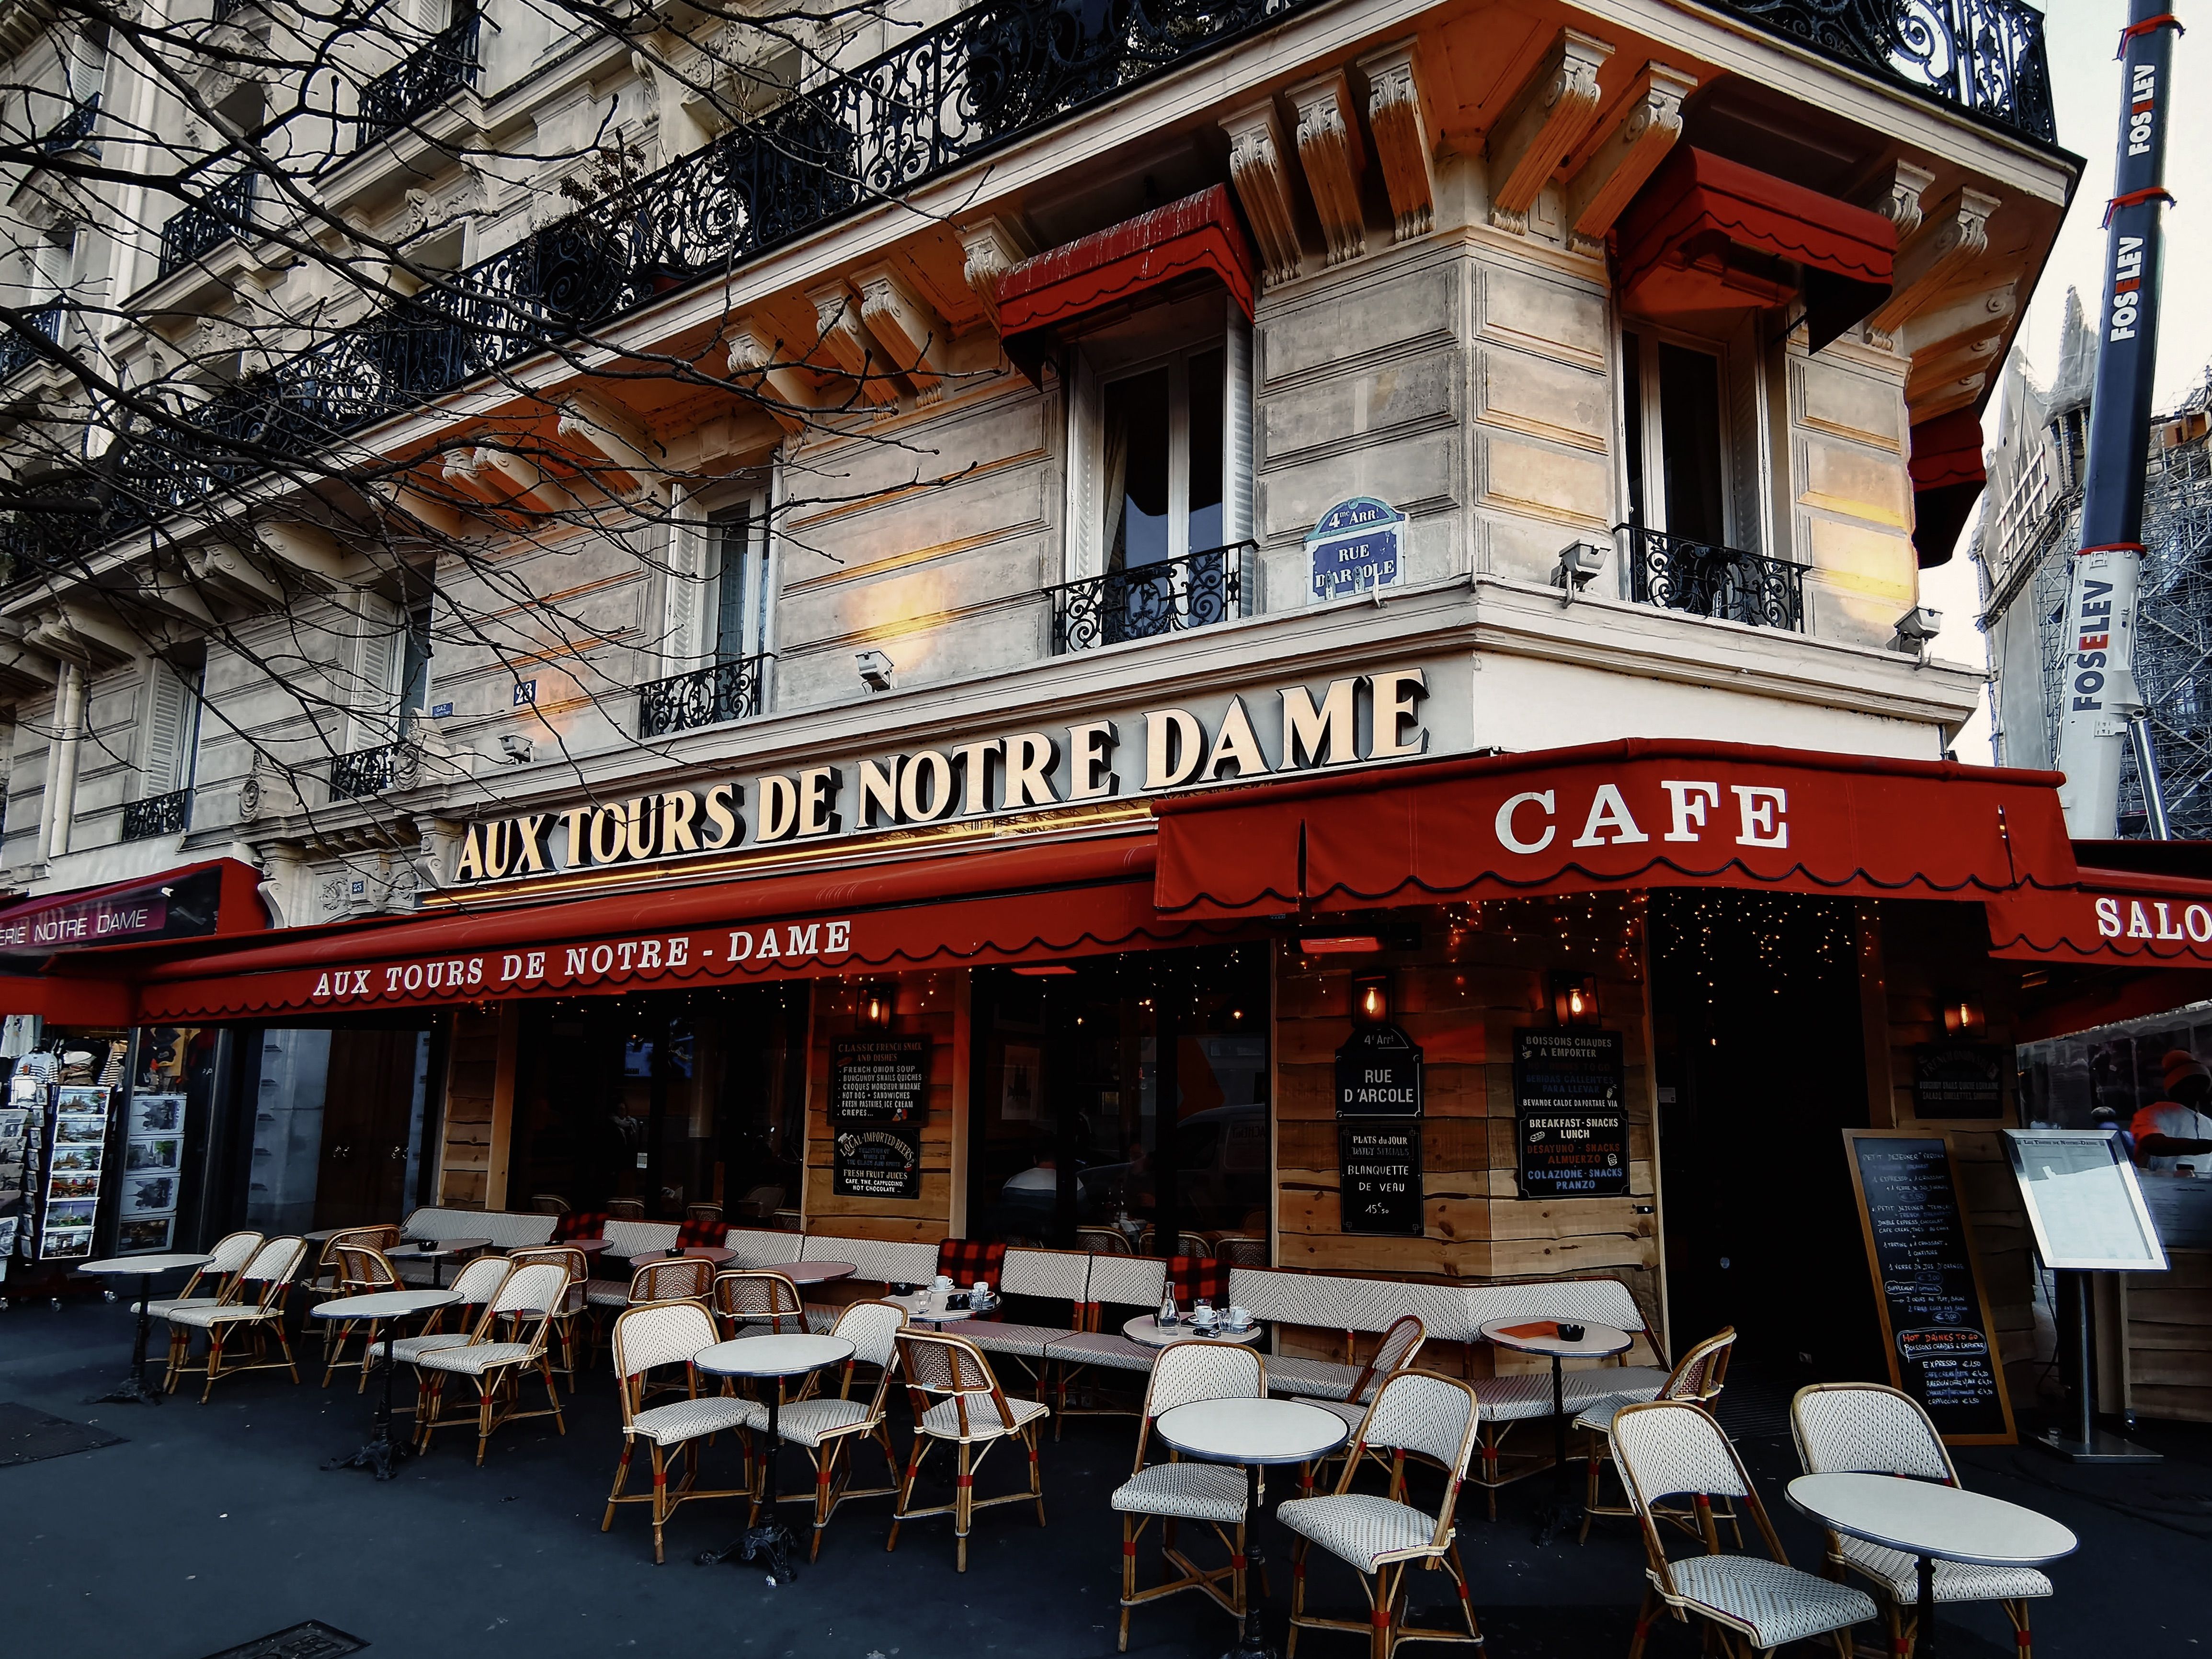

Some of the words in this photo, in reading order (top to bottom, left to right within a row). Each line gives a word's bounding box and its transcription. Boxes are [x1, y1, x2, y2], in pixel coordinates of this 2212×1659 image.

[2128, 65, 2155, 157] FOSELEV
[2109, 237, 2143, 342] FOSELEV
[1338, 544, 1370, 562] RUE
[2072, 579, 2113, 712] FOSELEV
[515, 682, 532, 704] 23
[452, 814, 556, 883] AUX
[559, 783, 746, 869] TOURS
[755, 766, 843, 844] DE
[855, 720, 1120, 830] NOTRE
[1141, 666, 1430, 792] DAME
[1494, 780, 1789, 854] CAFE
[34, 917, 88, 942] NOTRE
[97, 909, 148, 934] DAME
[2095, 897, 2212, 943] SALO
[313, 970, 371, 996] AUX
[386, 958, 483, 991] TOURS
[501, 952, 546, 981] DE
[564, 937, 689, 976] NOTRE
[727, 920, 851, 962] DAME
[838, 1043, 875, 1052] CLASSIC
[876, 1043, 901, 1051] FRENCH
[903, 1042, 922, 1050] SNACK
[1526, 1036, 1572, 1046] BOISSONS
[1574, 1038, 1612, 1047] CHAUDES
[873, 1054, 898, 1062] DISHES
[1540, 1048, 1547, 1056] A
[1551, 1048, 1596, 1057] EMPORTER
[897, 1074, 922, 1082] QUICHES
[1365, 1069, 1392, 1083] RUE
[1345, 1089, 1414, 1102] D'ARCOLE
[1529, 1119, 1581, 1128] BREAKFAST
[1586, 1118, 1619, 1127] SNACKS
[1561, 1129, 1590, 1139] LUNCH
[839, 1135, 863, 1157] LOCAL
[863, 1131, 896, 1146] IMPORTED
[894, 1138, 914, 1160] BEERS
[1353, 1136, 1377, 1144] PLATS
[1379, 1136, 1387, 1144] du
[1388, 1136, 1408, 1145] JOUR
[1527, 1144, 1574, 1154] DESAYUNO
[1585, 1143, 1620, 1152] SNACKS
[1548, 1155, 1601, 1164] ALMUERZO
[843, 1169, 864, 1177] FRESH
[866, 1170, 885, 1179] FRUIT
[886, 1171, 908, 1180] JUICES
[1348, 1165, 1409, 1175] BLANQUETTE
[1528, 1170, 1583, 1180] COLAZIONE
[1589, 1168, 1622, 1177] SNACKS
[1359, 1182, 1371, 1191] DE
[1380, 1182, 1404, 1192] VEAU
[1556, 1180, 1596, 1189] PRANZO
[1902, 1334, 1920, 1342] HOT
[1922, 1360, 1957, 1368] EXPRESSO
